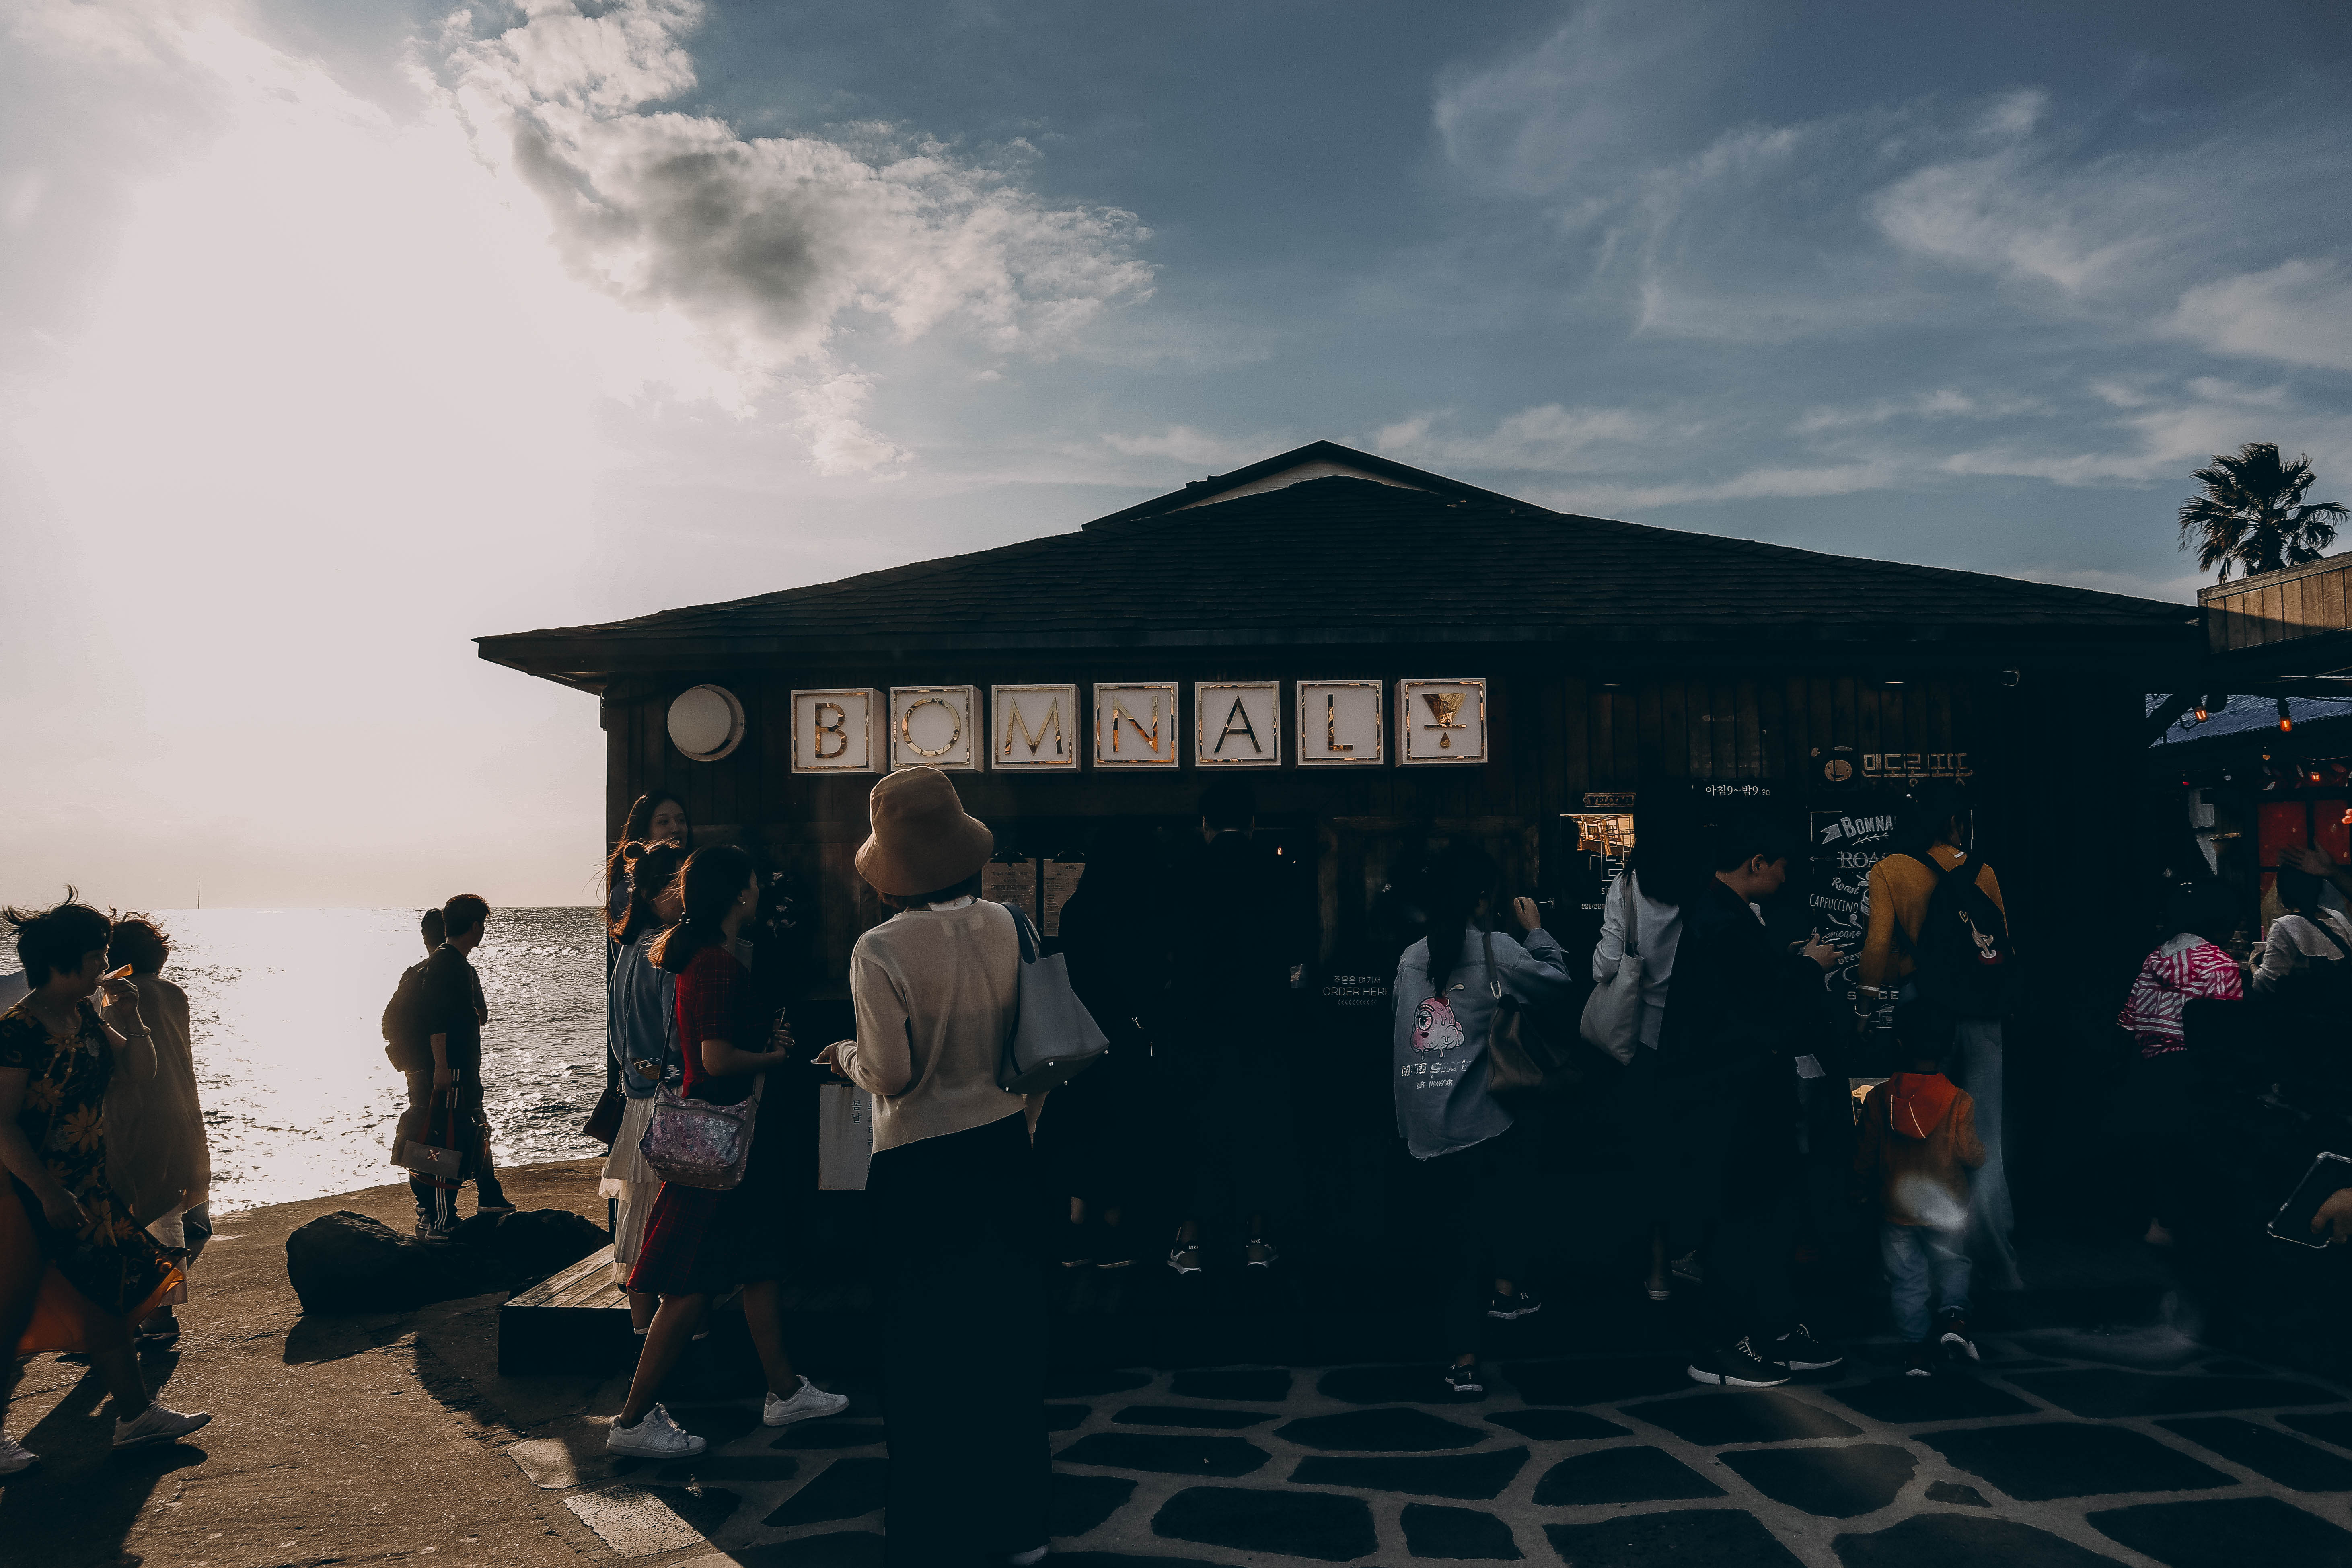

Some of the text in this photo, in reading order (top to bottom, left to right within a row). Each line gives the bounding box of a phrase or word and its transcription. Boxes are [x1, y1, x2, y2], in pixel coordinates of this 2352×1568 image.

[815, 693, 1354, 759] BOMNAL
[1840, 815, 1896, 838] BOMNA
[1838, 852, 1889, 868] ROA
[1832, 877, 1860, 894] Roast
[1811, 927, 1862, 939] Aericano
[1334, 976, 1381, 984] 주문은 여기서
[1323, 987, 1360, 996] ORDER
[1847, 991, 1899, 1000] SCE
[1429, 1079, 1454, 1089] MONSTER
[851, 1100, 862, 1124] 봄날
